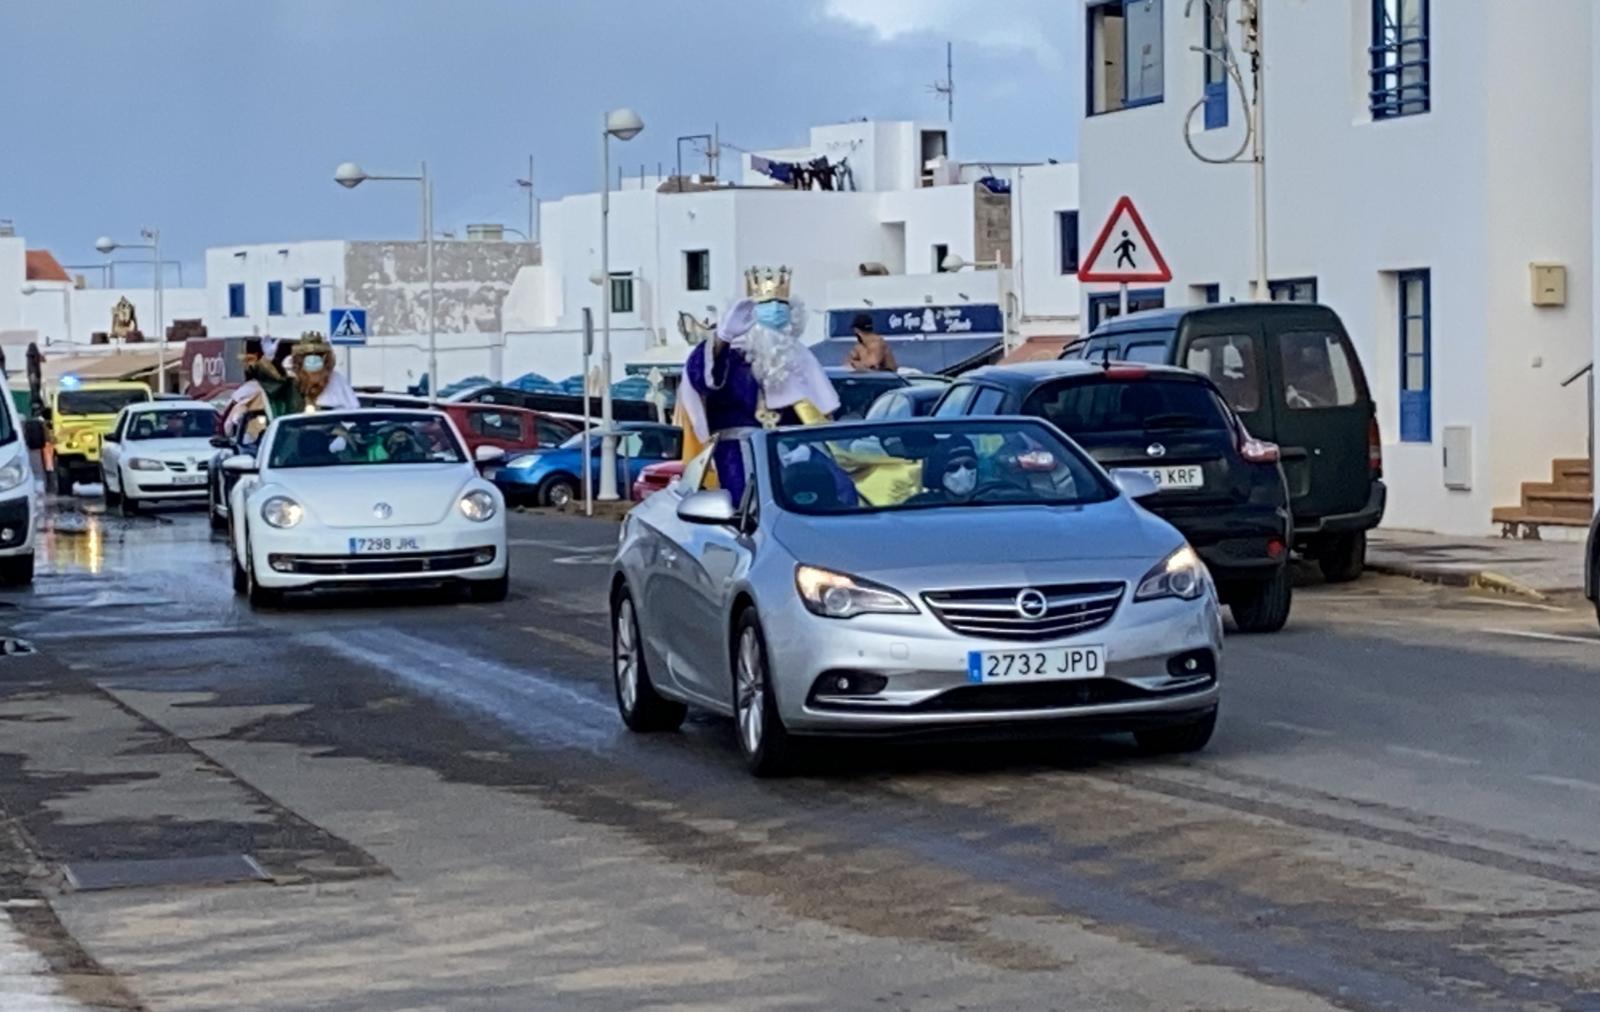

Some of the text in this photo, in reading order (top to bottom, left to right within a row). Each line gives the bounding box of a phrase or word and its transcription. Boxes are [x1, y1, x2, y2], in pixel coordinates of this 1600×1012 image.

[1167, 468, 1197, 484] KRF
[358, 538, 391, 550] 7298
[987, 650, 1098, 677] 2732 JPD
